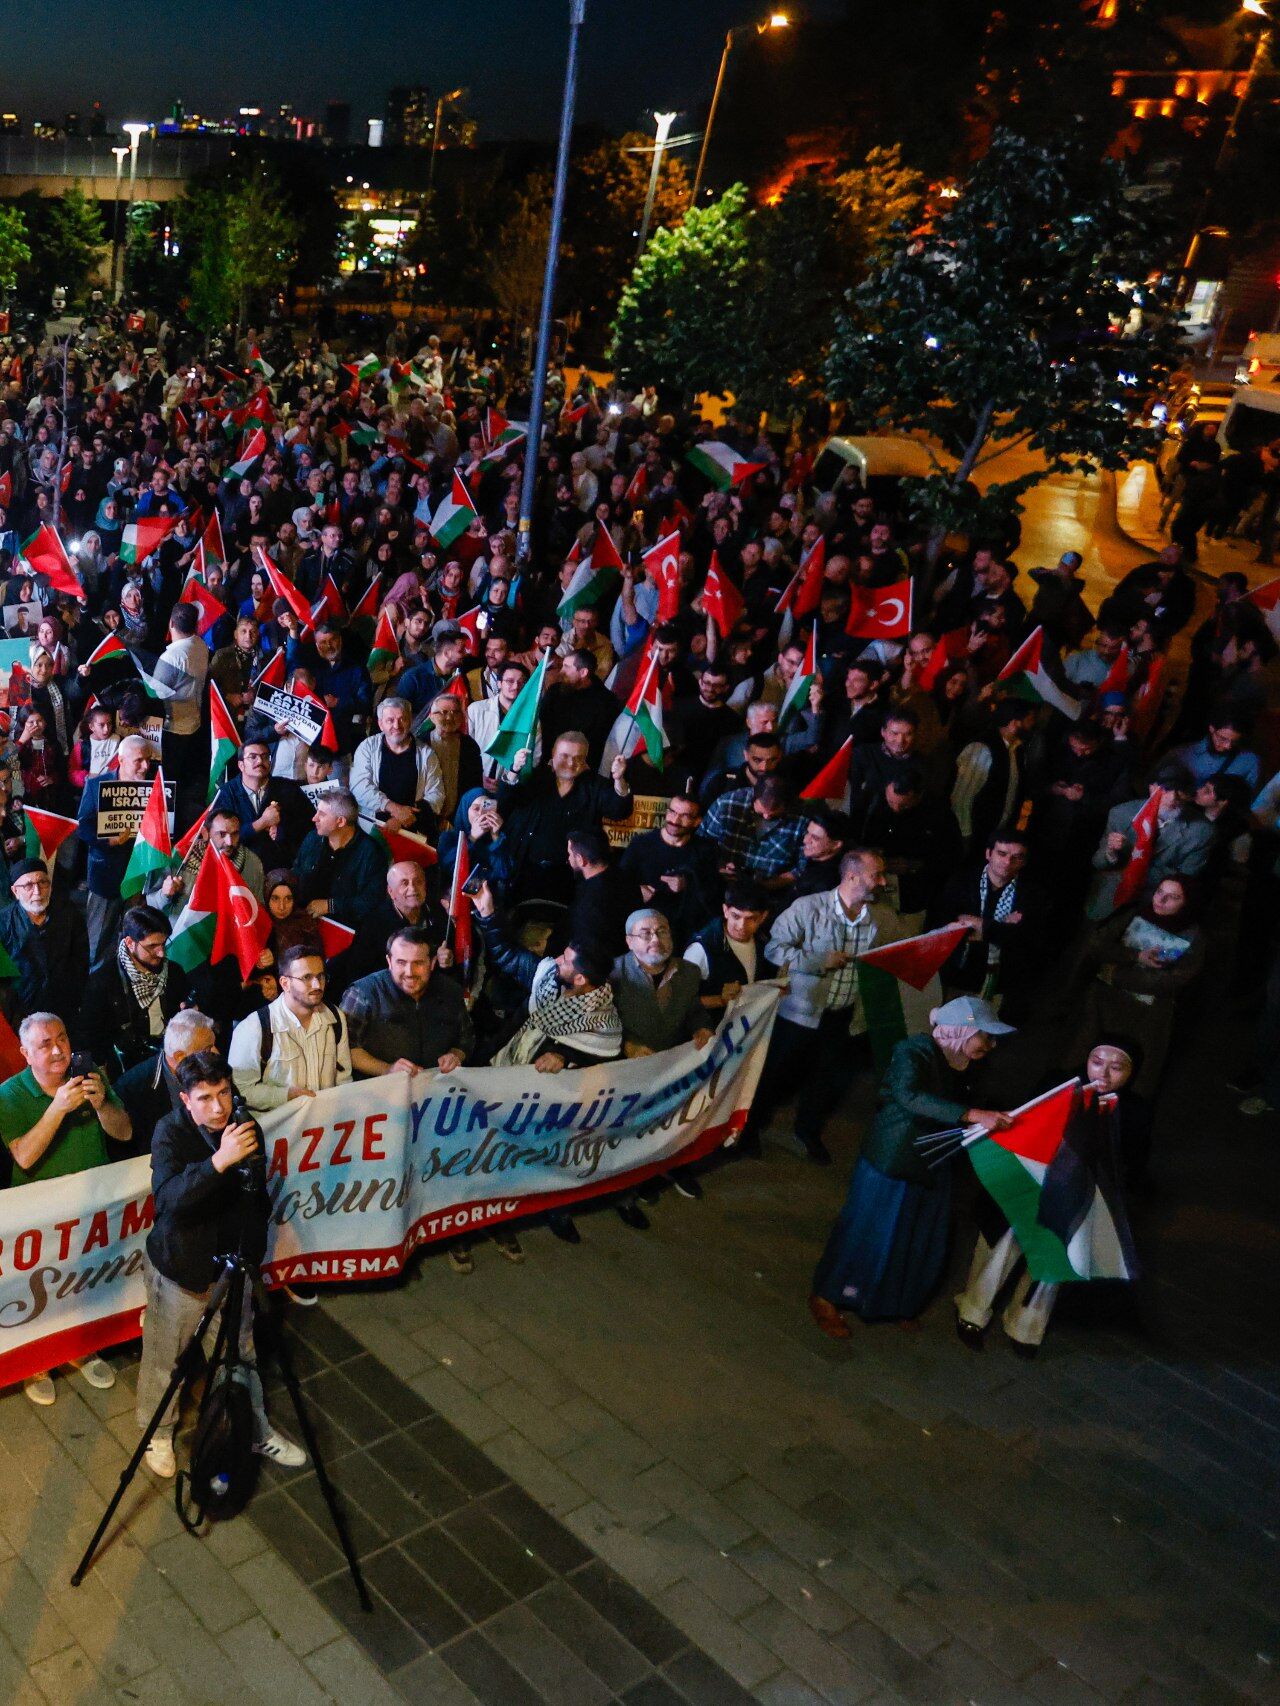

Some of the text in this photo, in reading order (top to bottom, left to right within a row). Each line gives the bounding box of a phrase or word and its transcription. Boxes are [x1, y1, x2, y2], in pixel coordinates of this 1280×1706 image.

[108, 813, 124, 822] GET
[104, 821, 136, 830] MIDDLE
[268, 1113, 388, 1181] AZZE
[410, 1086, 642, 1144] YÜKÜMÜZ
